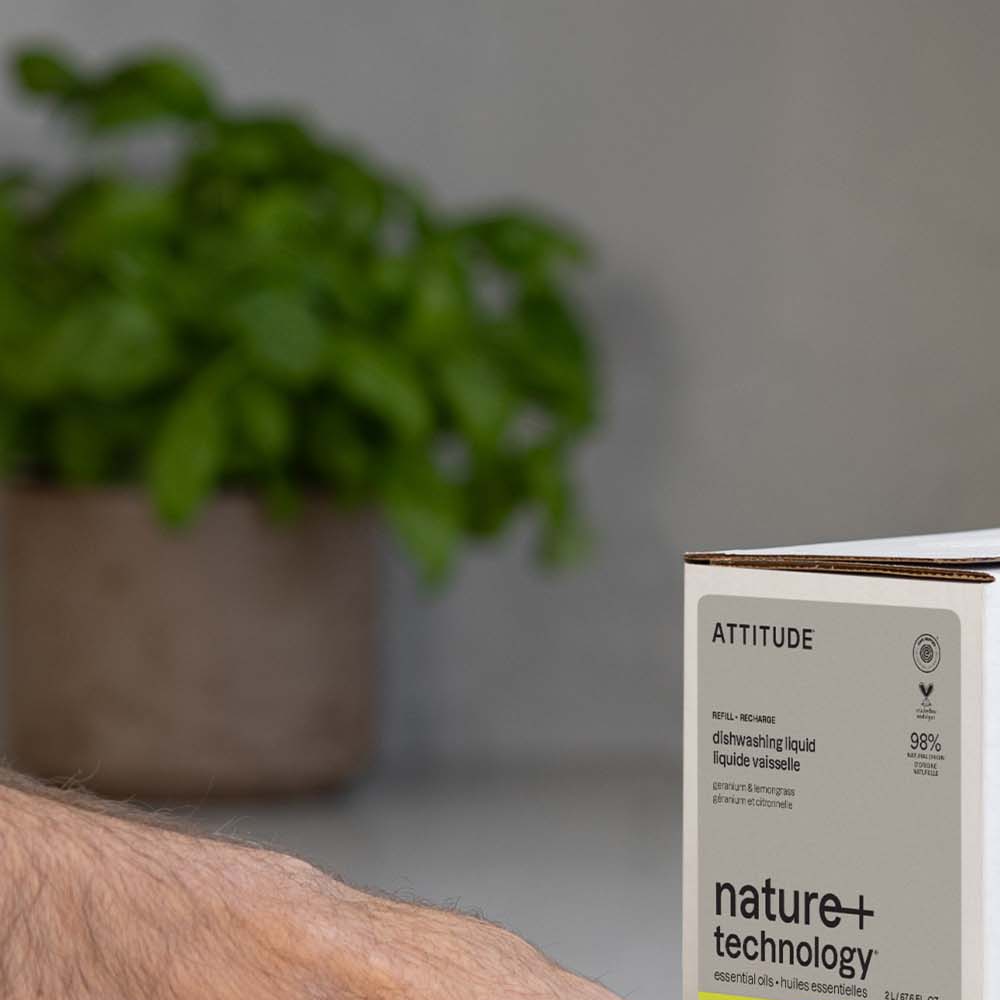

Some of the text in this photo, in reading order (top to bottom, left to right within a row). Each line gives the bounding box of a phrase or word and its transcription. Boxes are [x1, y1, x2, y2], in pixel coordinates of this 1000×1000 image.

[712, 622, 814, 650] ATTITUDE
[712, 711, 776, 724] REFILL RECHARGE
[712, 730, 816, 754] dishwashing liquid
[910, 732, 942, 752] 98%
[713, 751, 801, 772] liquide vaisselle
[747, 783, 753, 793] &
[714, 969, 868, 999] essential oils huiles essentielles
[884, 990, 890, 1000] 2
